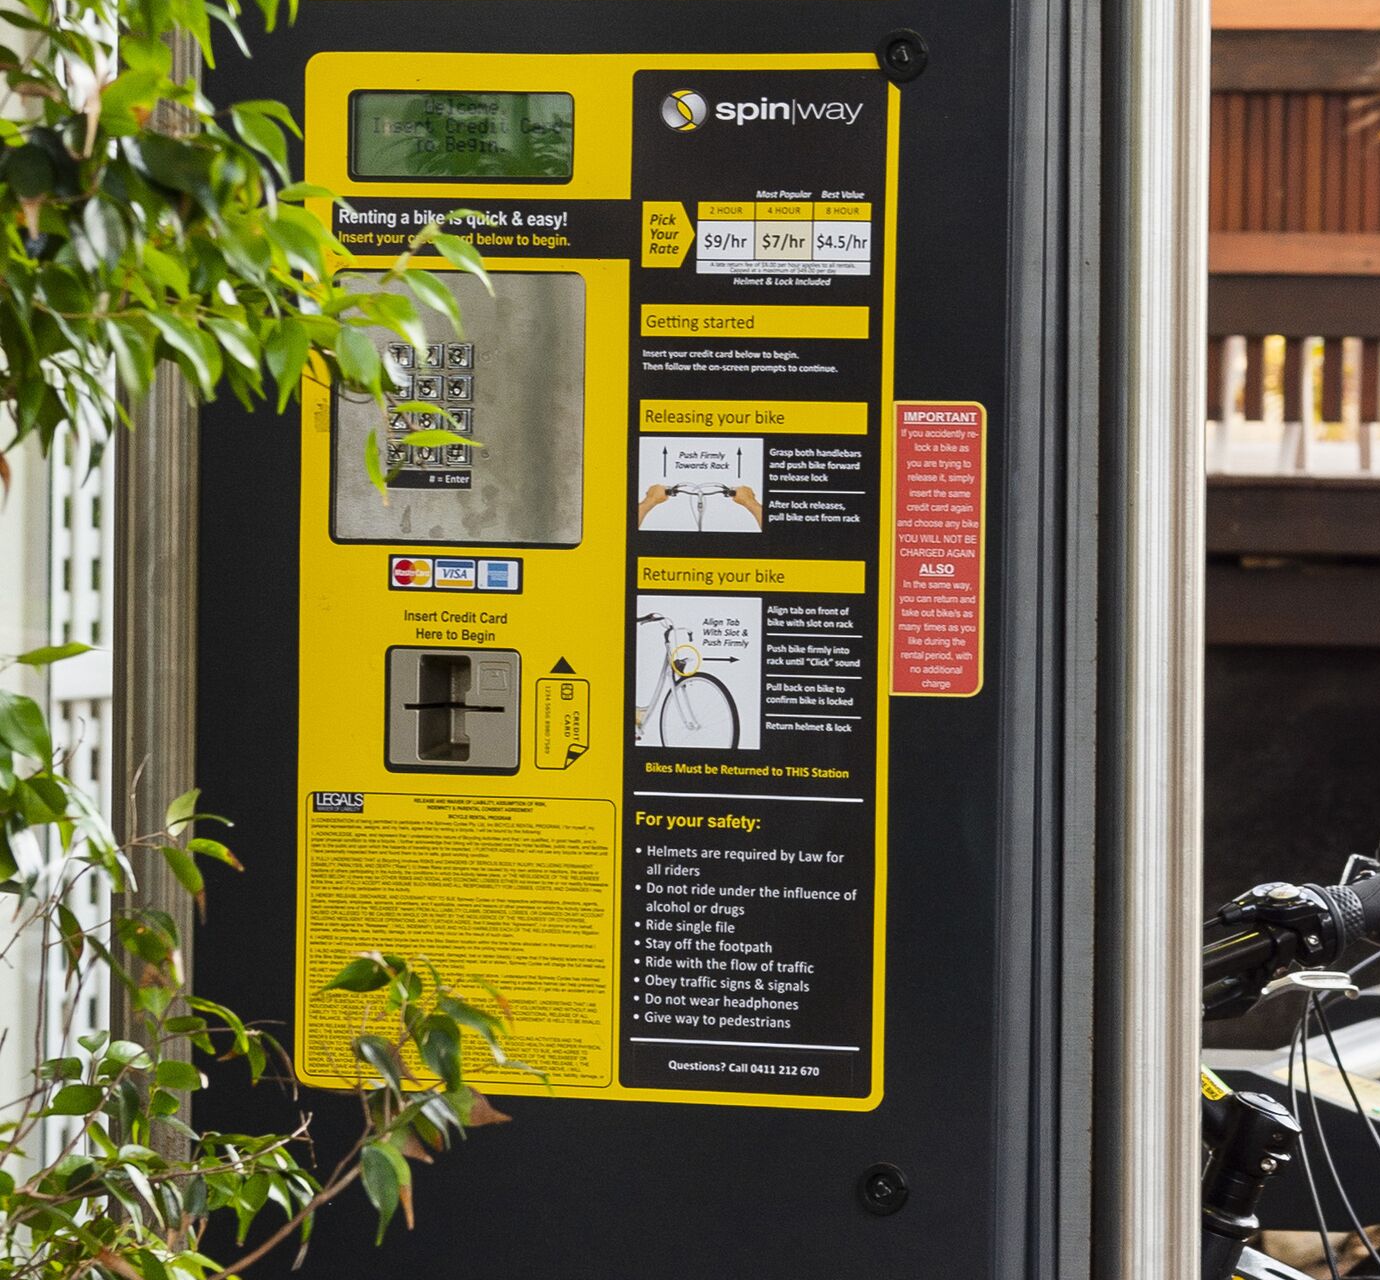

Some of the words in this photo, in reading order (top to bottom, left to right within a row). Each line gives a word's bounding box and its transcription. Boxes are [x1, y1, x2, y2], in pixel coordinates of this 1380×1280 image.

[779, 190, 811, 199] Popular
[841, 191, 865, 199] Value
[826, 207, 831, 215] 8
[834, 207, 859, 215] HOUR
[339, 209, 396, 227] Renting
[401, 213, 410, 224] a
[414, 210, 445, 225] bike
[450, 211, 462, 225] is
[466, 211, 506, 229] quick
[512, 212, 523, 226] &
[527, 212, 568, 230] easy!
[650, 214, 675, 225] Pick
[339, 231, 373, 244] Insert
[377, 232, 404, 246] your
[477, 232, 512, 245] below
[516, 234, 528, 245] to
[532, 234, 570, 249] begin.
[650, 229, 679, 240] Your
[704, 234, 747, 250] $9/hr
[762, 234, 805, 250] $7/hr
[816, 234, 867, 250] $4.5/hr
[650, 244, 679, 254] Rate
[795, 278, 831, 286] Included
[646, 315, 699, 331] Getting
[703, 315, 754, 329] started
[643, 349, 666, 358] Insert
[669, 351, 687, 359] your
[689, 350, 713, 358] credit
[715, 350, 733, 359] card
[735, 350, 760, 359] below
[763, 351, 772, 359] to
[774, 351, 799, 360] begin.
[646, 409, 713, 426] Releasing
[719, 412, 750, 426] your
[755, 410, 785, 424] bike
[904, 412, 977, 422] IMPORTANT
[445, 475, 469, 484] Enter
[442, 569, 467, 579] VISA
[643, 568, 713, 584] Returning
[719, 570, 750, 585] your
[755, 569, 785, 584] bike
[920, 564, 954, 574] ALSO
[404, 610, 437, 622] Insert
[441, 611, 476, 623] Credit
[480, 612, 507, 624] Card
[416, 628, 442, 640] Here
[447, 629, 457, 640] to
[462, 629, 495, 644] Begin
[646, 762, 673, 773] Bikes
[675, 763, 702, 774] Must
[705, 764, 718, 774] be
[721, 764, 769, 776] Returned
[772, 766, 782, 776] to
[785, 767, 809, 778] THIS
[811, 768, 849, 779] Station
[317, 793, 363, 807] LEGALS
[636, 811, 662, 826] For
[667, 814, 703, 830] your
[708, 814, 761, 832] safety:
[647, 846, 697, 858] Helmets
[701, 850, 721, 860] are
[724, 849, 776, 862] required
[780, 851, 795, 863] by
[799, 851, 822, 863] Law
[826, 851, 844, 863] for
[647, 865, 660, 876] all
[665, 865, 700, 877] riders
[647, 883, 663, 894] Do
[667, 884, 688, 895] not
[692, 884, 715, 896] ride
[719, 885, 755, 898] under
[759, 886, 779, 898] the
[784, 888, 840, 900] influence
[843, 889, 857, 900] of
[646, 901, 690, 913] alcohol
[694, 905, 706, 914] or
[710, 903, 744, 917] drugs
[646, 920, 672, 932] Ride
[676, 920, 712, 934] single
[716, 922, 735, 933] file
[646, 938, 670, 952] Stay
[675, 939, 692, 950] off
[696, 939, 716, 951] the
[719, 940, 772, 954] footpath
[646, 957, 672, 968] Ride
[676, 958, 702, 969] with
[706, 959, 727, 970] the
[730, 959, 757, 971] flow
[761, 960, 773, 972] of
[777, 961, 814, 974] traffic
[646, 975, 677, 989] Obey
[681, 976, 717, 989] traffic
[720, 978, 750, 991] signs
[754, 979, 764, 990] &
[768, 980, 809, 993] signals
[646, 994, 662, 1005] Do
[666, 995, 686, 1006] not
[690, 997, 720, 1007] wear
[723, 997, 799, 1011] headphones
[644, 1012, 671, 1024] Give
[675, 1016, 699, 1027] way
[702, 1015, 716, 1026] to
[719, 1015, 791, 1029] pedestrians
[668, 1060, 726, 1072] Questions?
[729, 1063, 748, 1073] Call
[751, 1063, 776, 1074] 0411
[779, 1065, 798, 1075] 212
[800, 1066, 819, 1076] 670
